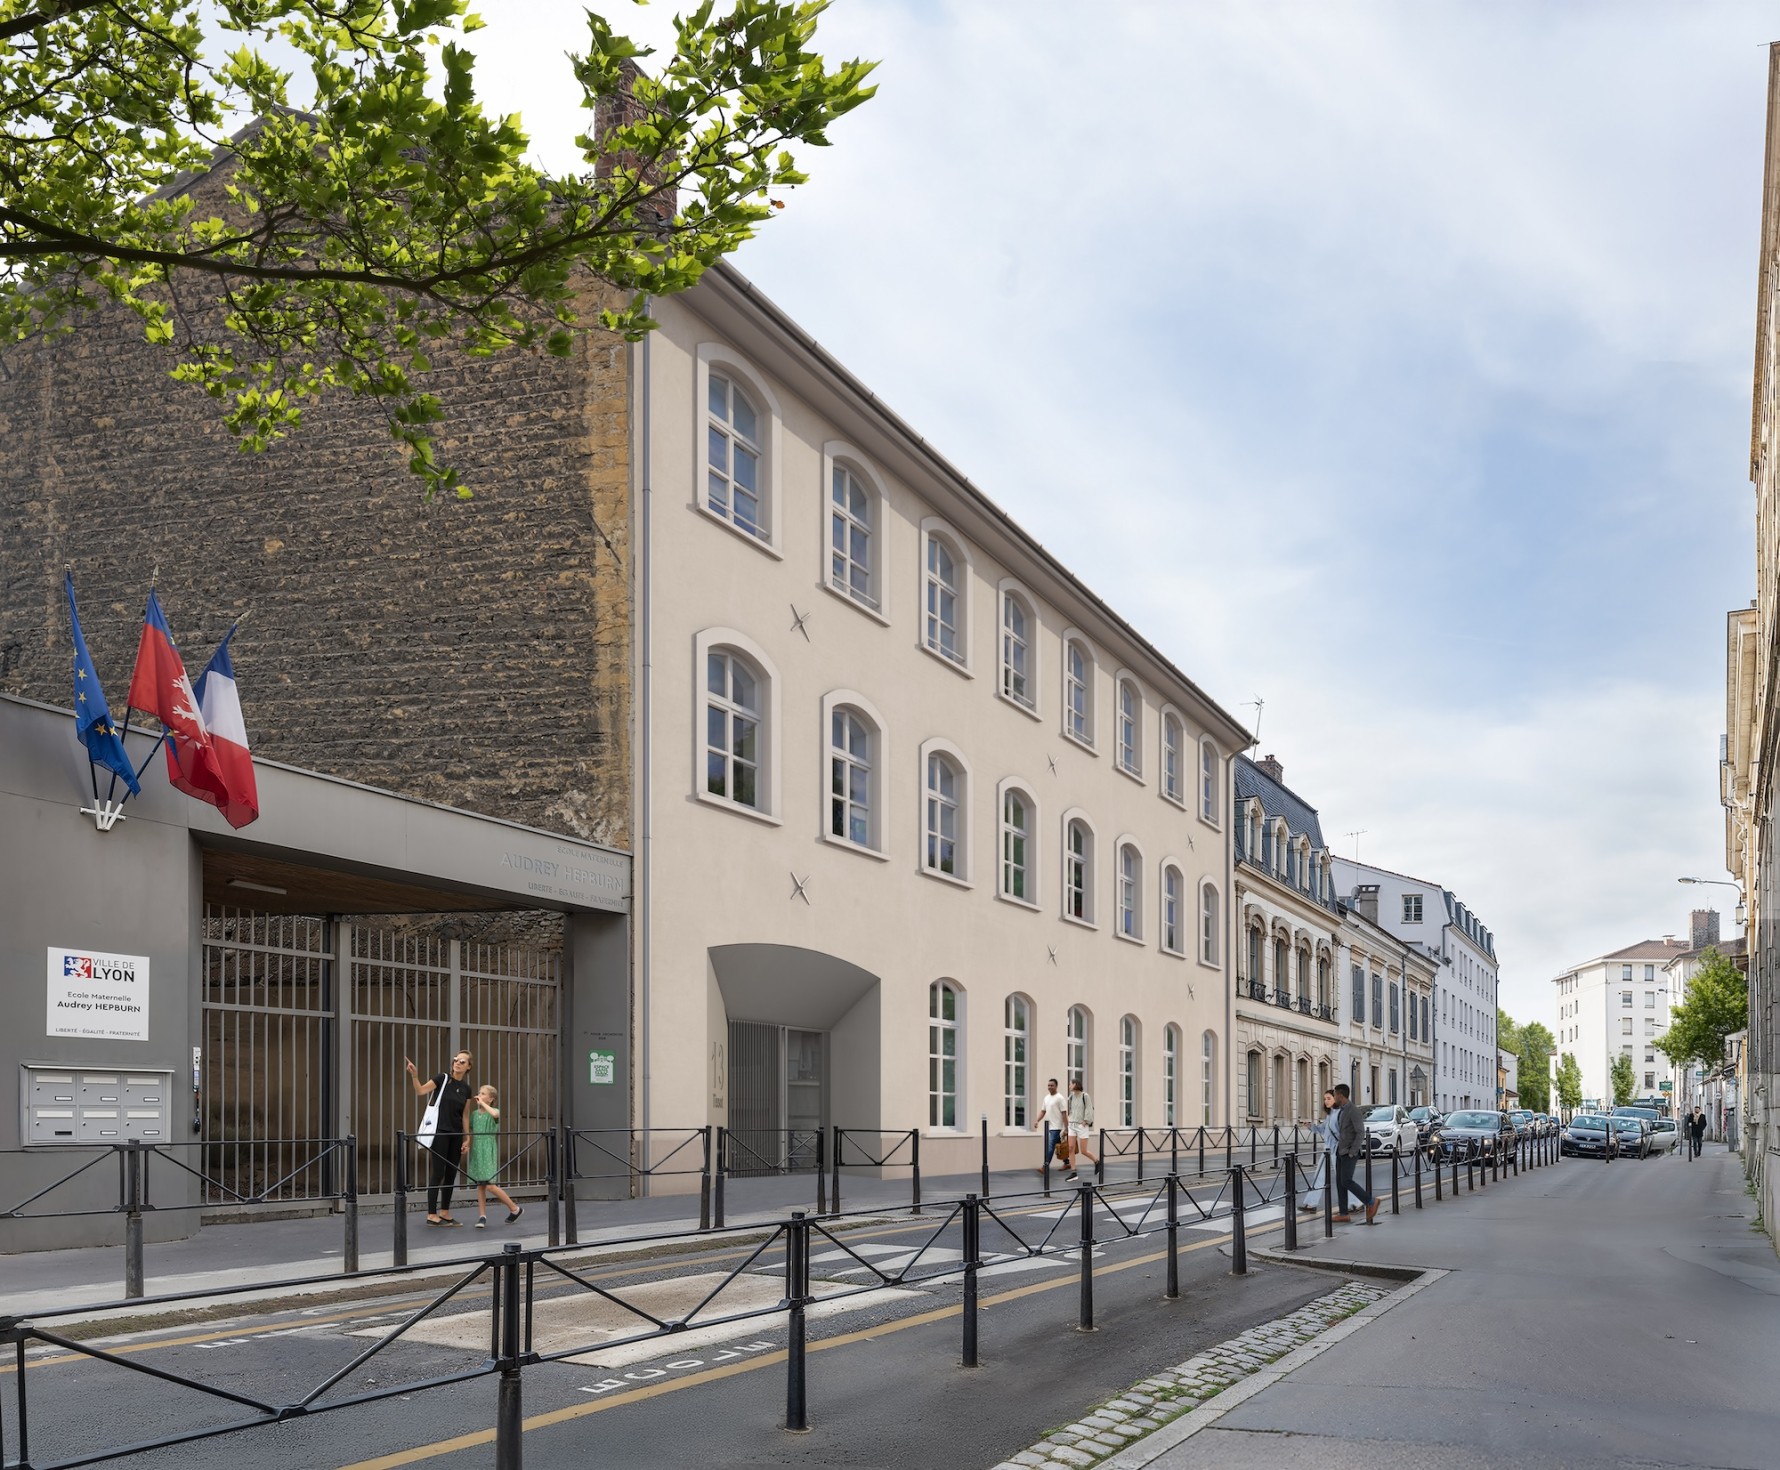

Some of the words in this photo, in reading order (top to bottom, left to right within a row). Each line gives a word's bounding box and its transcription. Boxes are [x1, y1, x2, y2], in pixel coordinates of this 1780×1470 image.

[501, 852, 560, 877] AUDREY
[564, 865, 624, 892] HEPBURN
[93, 959, 119, 968] VILLE
[122, 961, 135, 970] DE
[93, 967, 135, 982] LYON
[67, 991, 89, 999] Ecole
[91, 993, 132, 1002] Maternelle
[57, 1001, 93, 1011] Audrey
[95, 1003, 141, 1012] HEPBURN
[711, 1041, 724, 1090] 13
[577, 1341, 777, 1394] ECOLE
